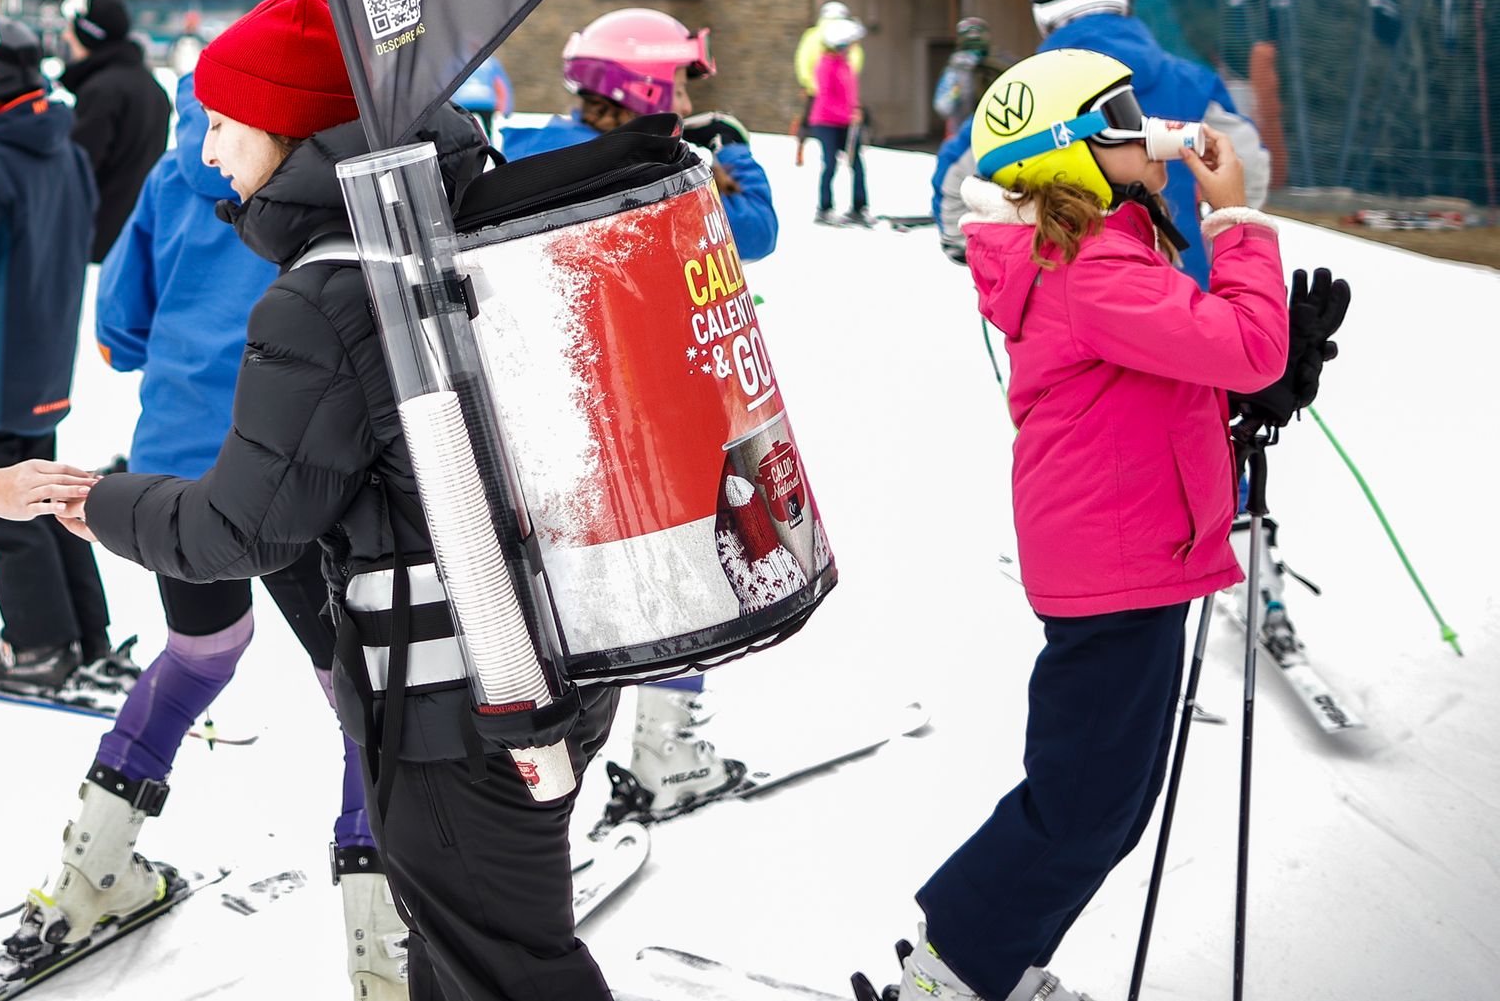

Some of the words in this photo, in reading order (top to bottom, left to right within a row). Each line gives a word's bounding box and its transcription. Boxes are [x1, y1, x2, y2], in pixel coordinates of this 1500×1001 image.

[703, 209, 726, 245] UN
[684, 242, 744, 307] CALD
[712, 344, 733, 378] &
[732, 326, 773, 396] GO
[770, 456, 793, 483] CALDO
[660, 767, 711, 787] HEAD
